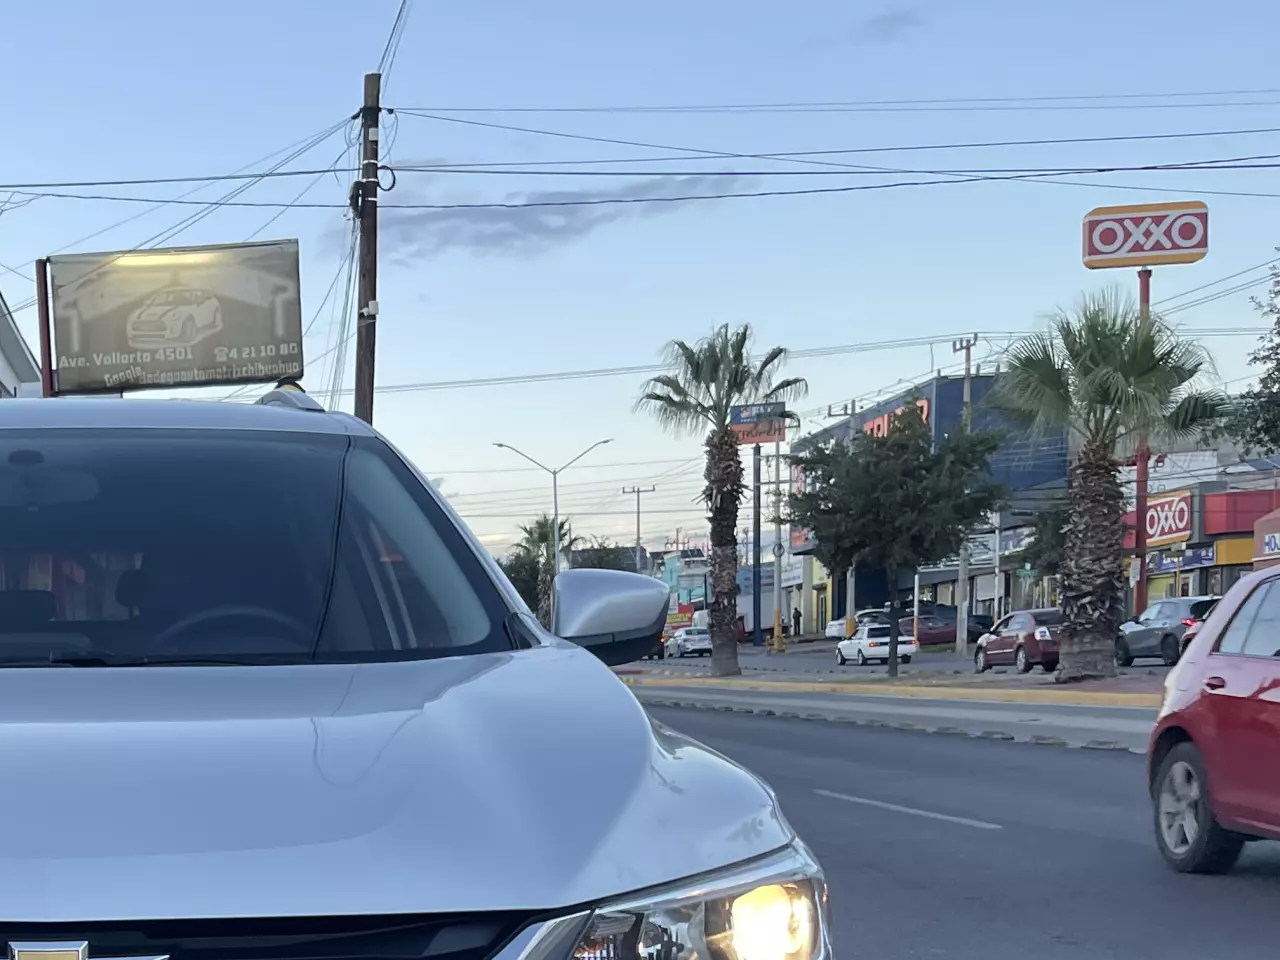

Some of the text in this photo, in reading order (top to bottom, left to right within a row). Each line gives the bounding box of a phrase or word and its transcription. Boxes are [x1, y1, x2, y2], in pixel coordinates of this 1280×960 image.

[1092, 211, 1204, 255] OXXO
[59, 347, 193, 368] Ave. Vallarta 4501
[104, 365, 144, 387] Google
[1146, 499, 1188, 537] OXXO
